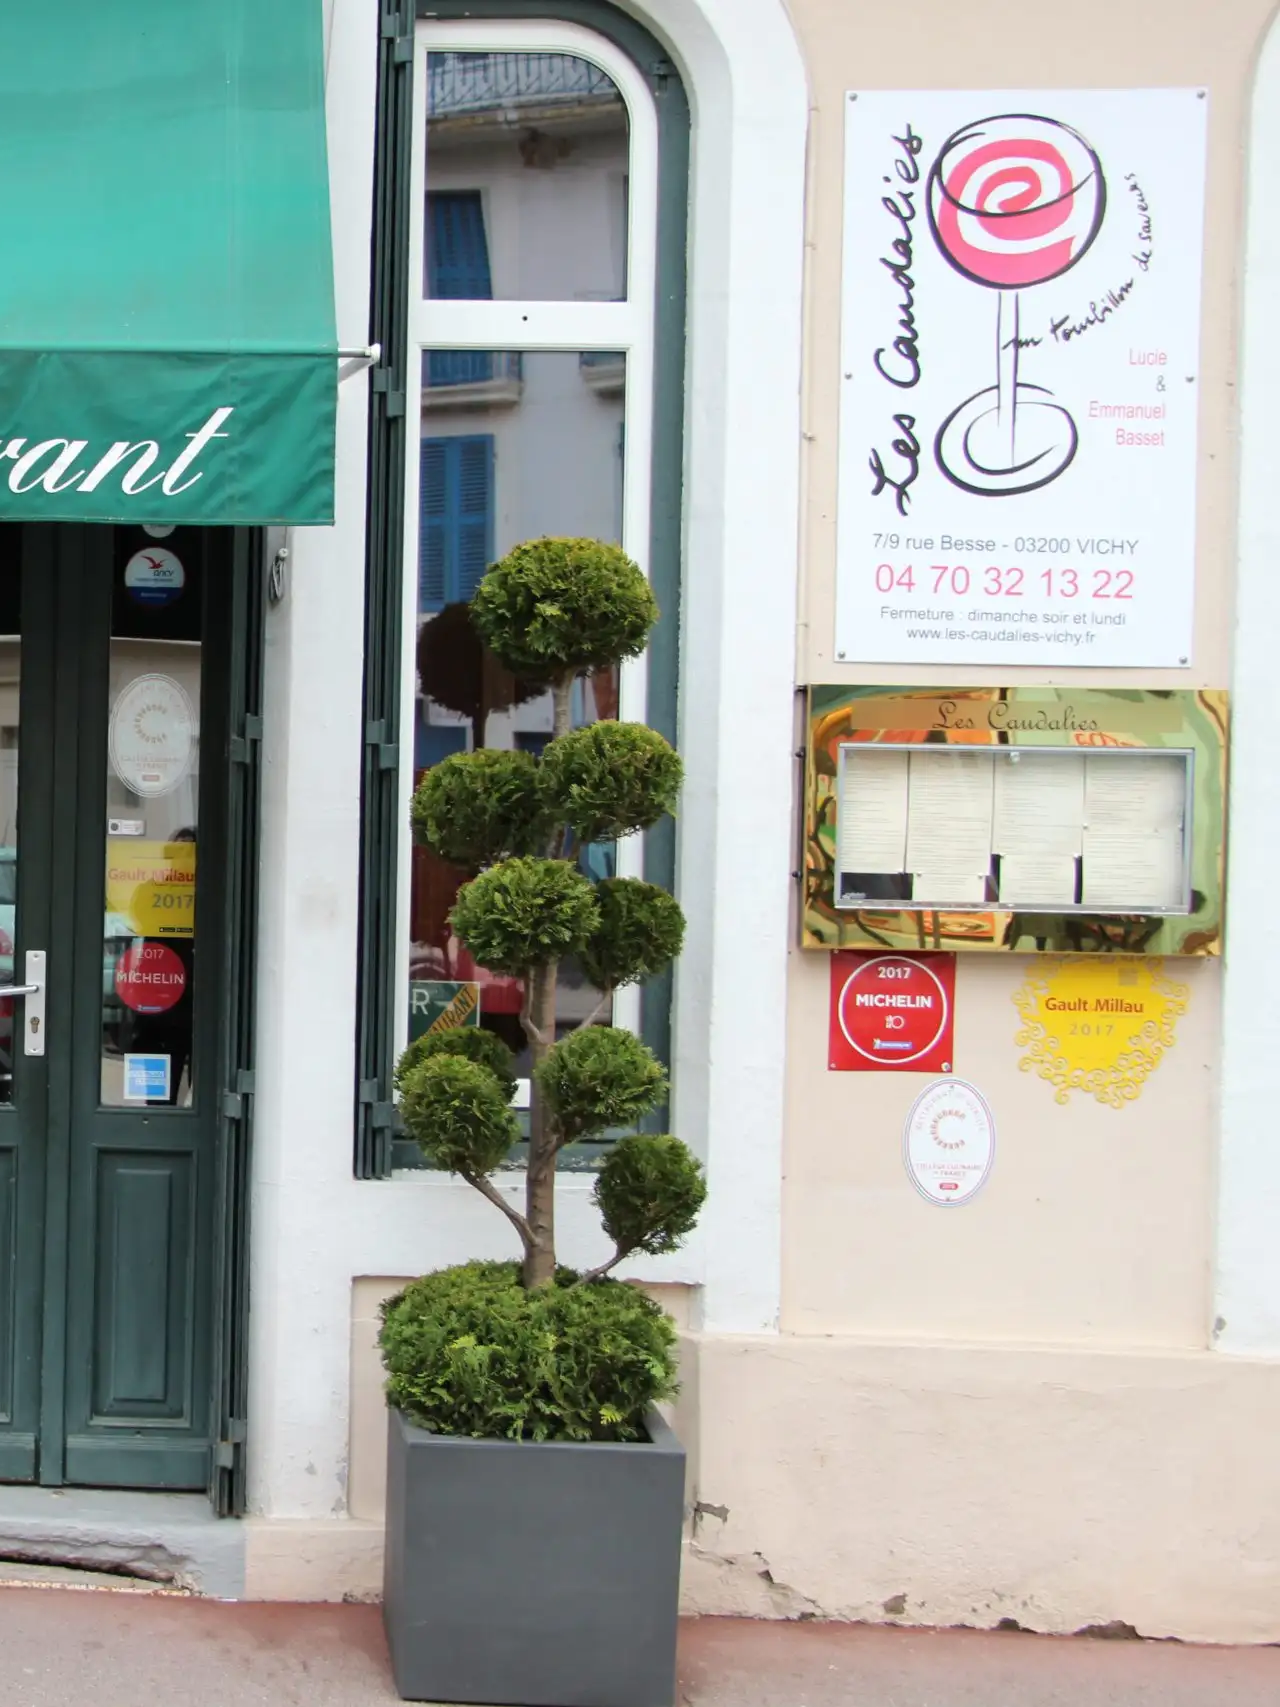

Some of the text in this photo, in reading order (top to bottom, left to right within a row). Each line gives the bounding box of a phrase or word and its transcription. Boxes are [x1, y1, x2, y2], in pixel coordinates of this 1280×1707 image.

[1123, 172, 1152, 242] saveurs
[1131, 249, 1152, 272] de
[869, 123, 923, 516] Les Caudalies
[1049, 278, 1134, 342] tourbillon
[1129, 348, 1167, 366] Lucie
[1156, 376, 1167, 392] &
[1088, 401, 1166, 420] Emmanuel
[1115, 428, 1165, 447] Basset
[872, 533, 900, 550] 7/9
[906, 538, 934, 551] rue
[940, 535, 996, 552] Besse
[1014, 536, 1070, 554] 03200
[1076, 538, 1140, 555] VICHY
[875, 564, 1134, 599] 04 70 32 13 22
[880, 606, 954, 622] Fermeture
[967, 609, 1038, 624] dimanche
[1042, 611, 1069, 624] soir
[1073, 612, 1087, 625] et
[1091, 611, 1126, 626] lundi
[906, 627, 1095, 646] www.les-caudalies-vichy.fr
[932, 701, 1101, 731] Les Caudalies
[107, 867, 195, 883] Gault Millau
[152, 893, 194, 910] 2017
[136, 948, 165, 960] 2017
[115, 970, 185, 985] MICHELIN
[877, 966, 912, 980] 2017
[411, 987, 431, 1015] R
[855, 994, 932, 1009] MICHELIN
[1044, 997, 1145, 1014] Gault Millau
[1068, 1023, 1114, 1037] 2017
